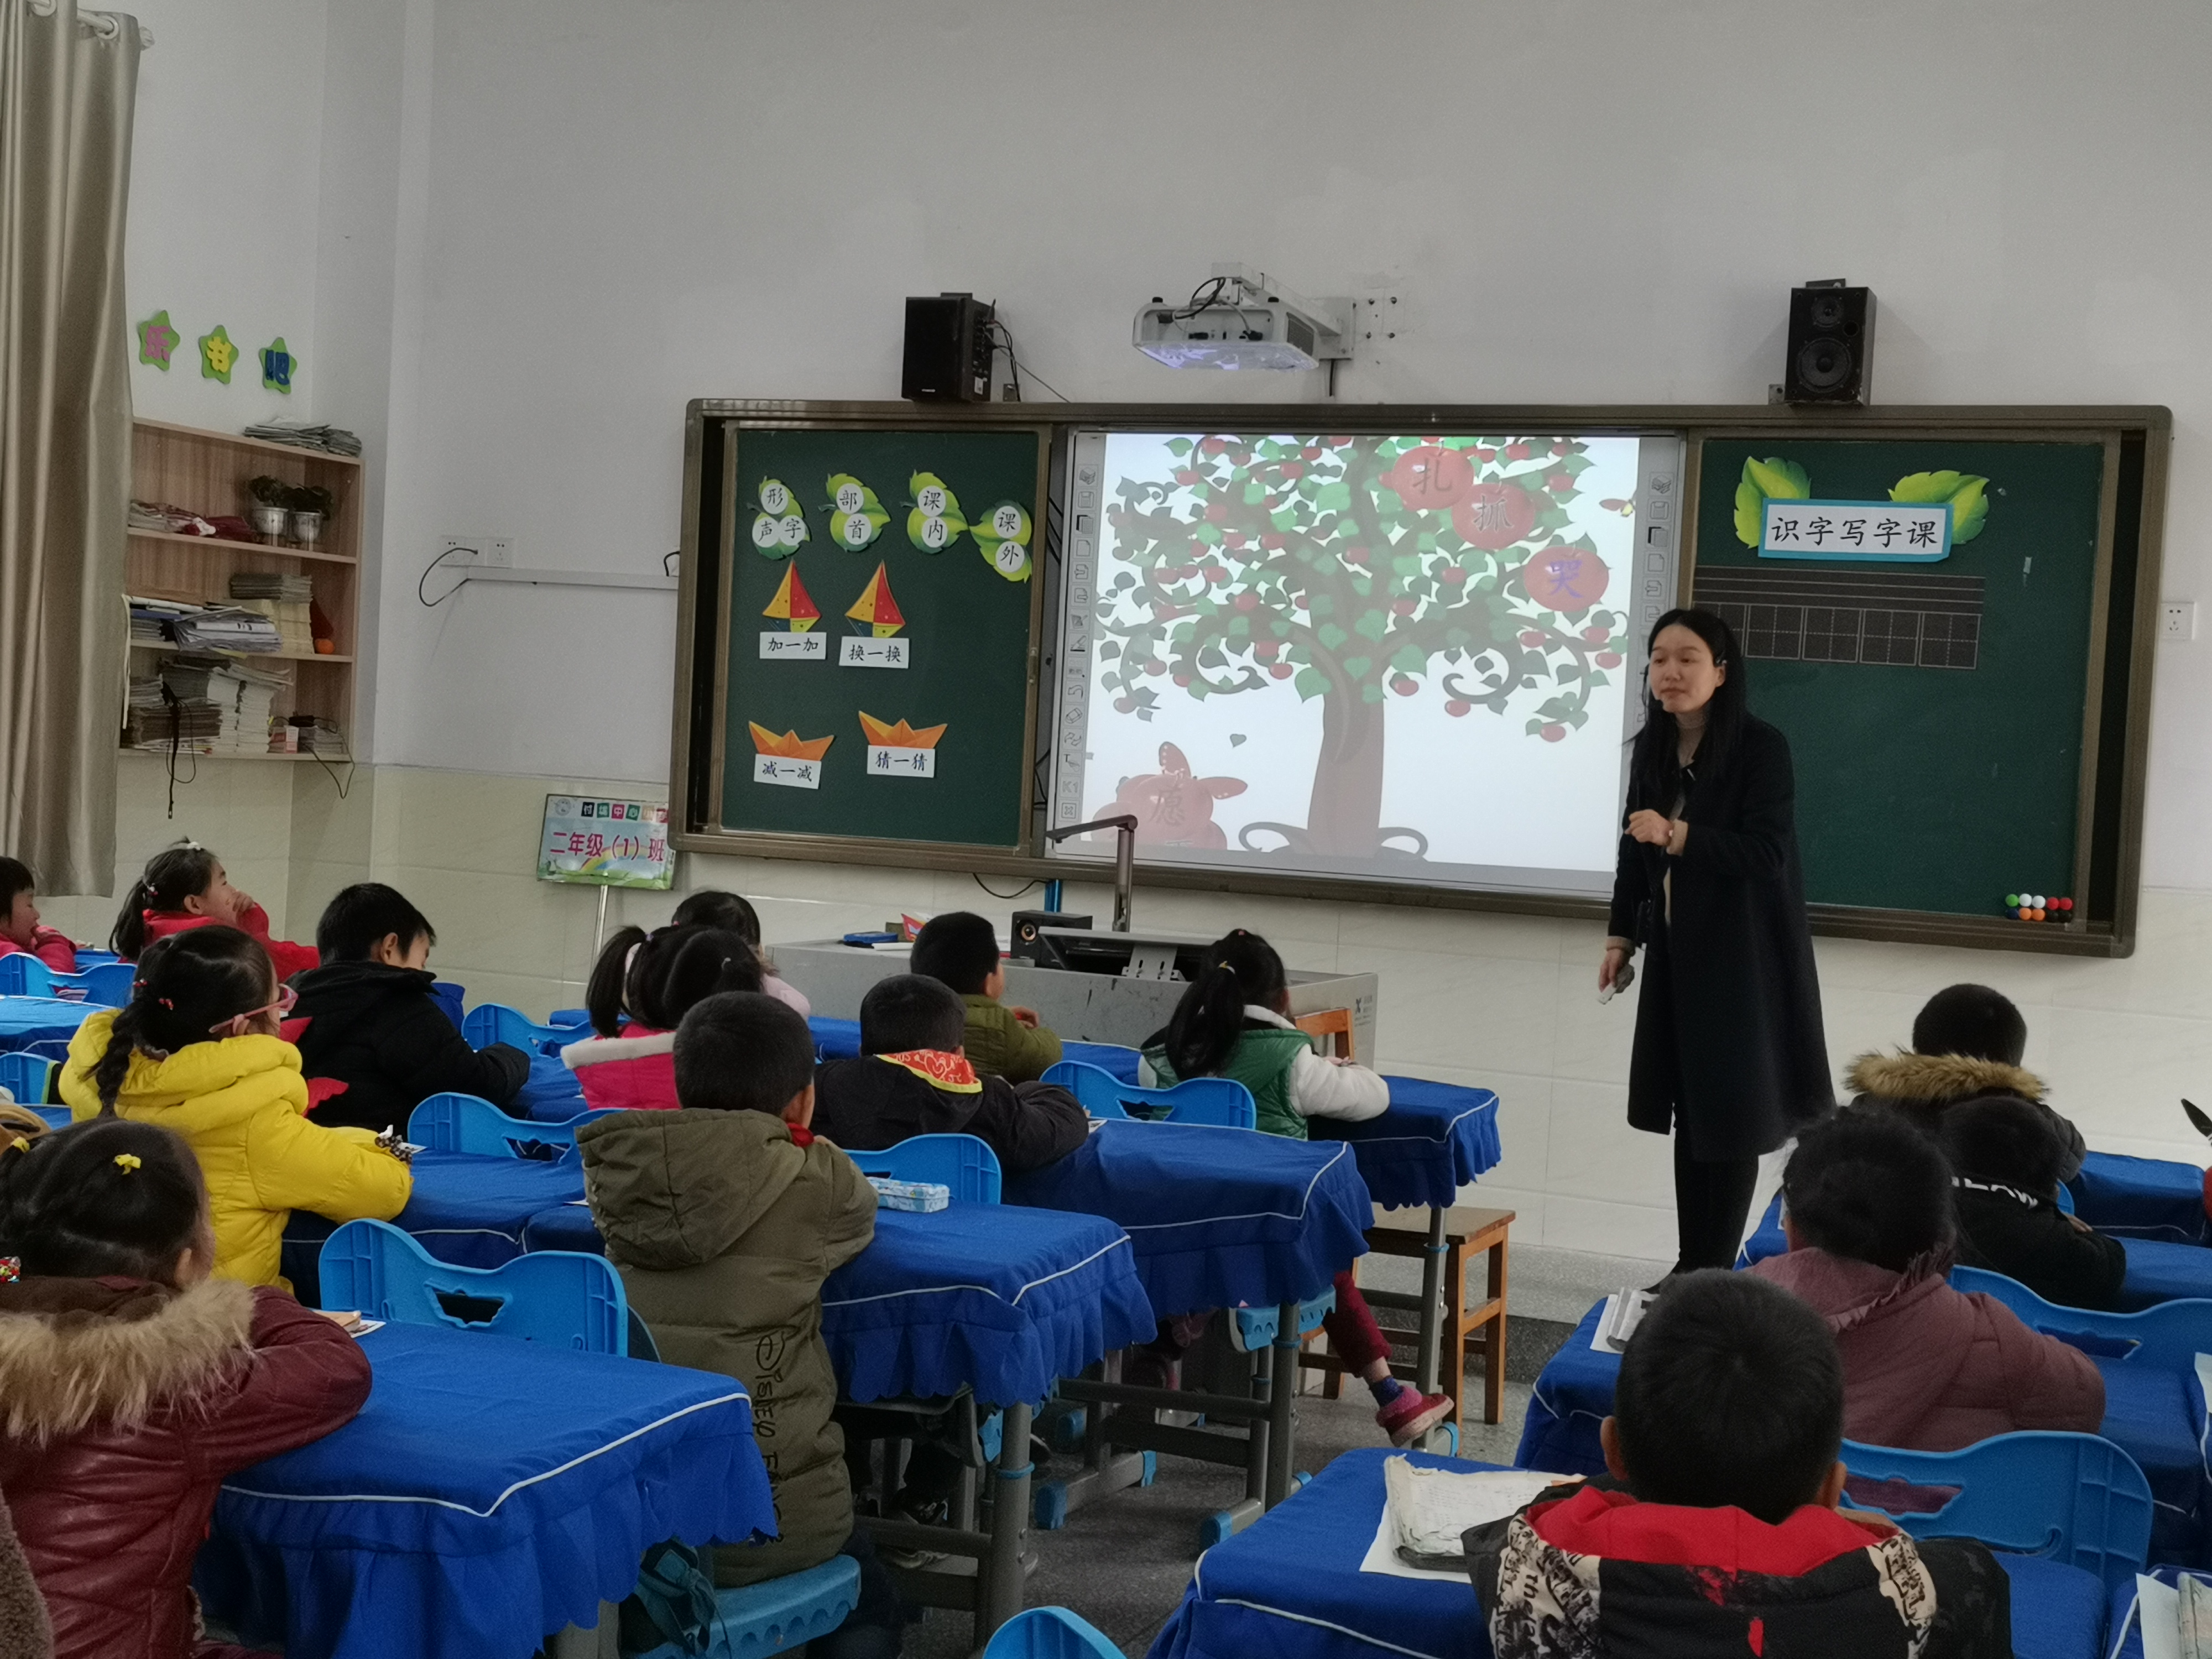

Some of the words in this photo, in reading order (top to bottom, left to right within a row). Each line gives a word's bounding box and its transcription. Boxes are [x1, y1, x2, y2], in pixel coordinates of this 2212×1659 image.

[1412, 458, 1452, 494] 扎
[839, 490, 866, 539] 部首
[1472, 495, 1514, 531] 抓
[1771, 517, 1938, 549] 识字写字课
[768, 637, 819, 651] 加一加
[848, 644, 903, 662] 换一换
[762, 761, 812, 782] 减一减
[875, 751, 928, 772] 猜一猜
